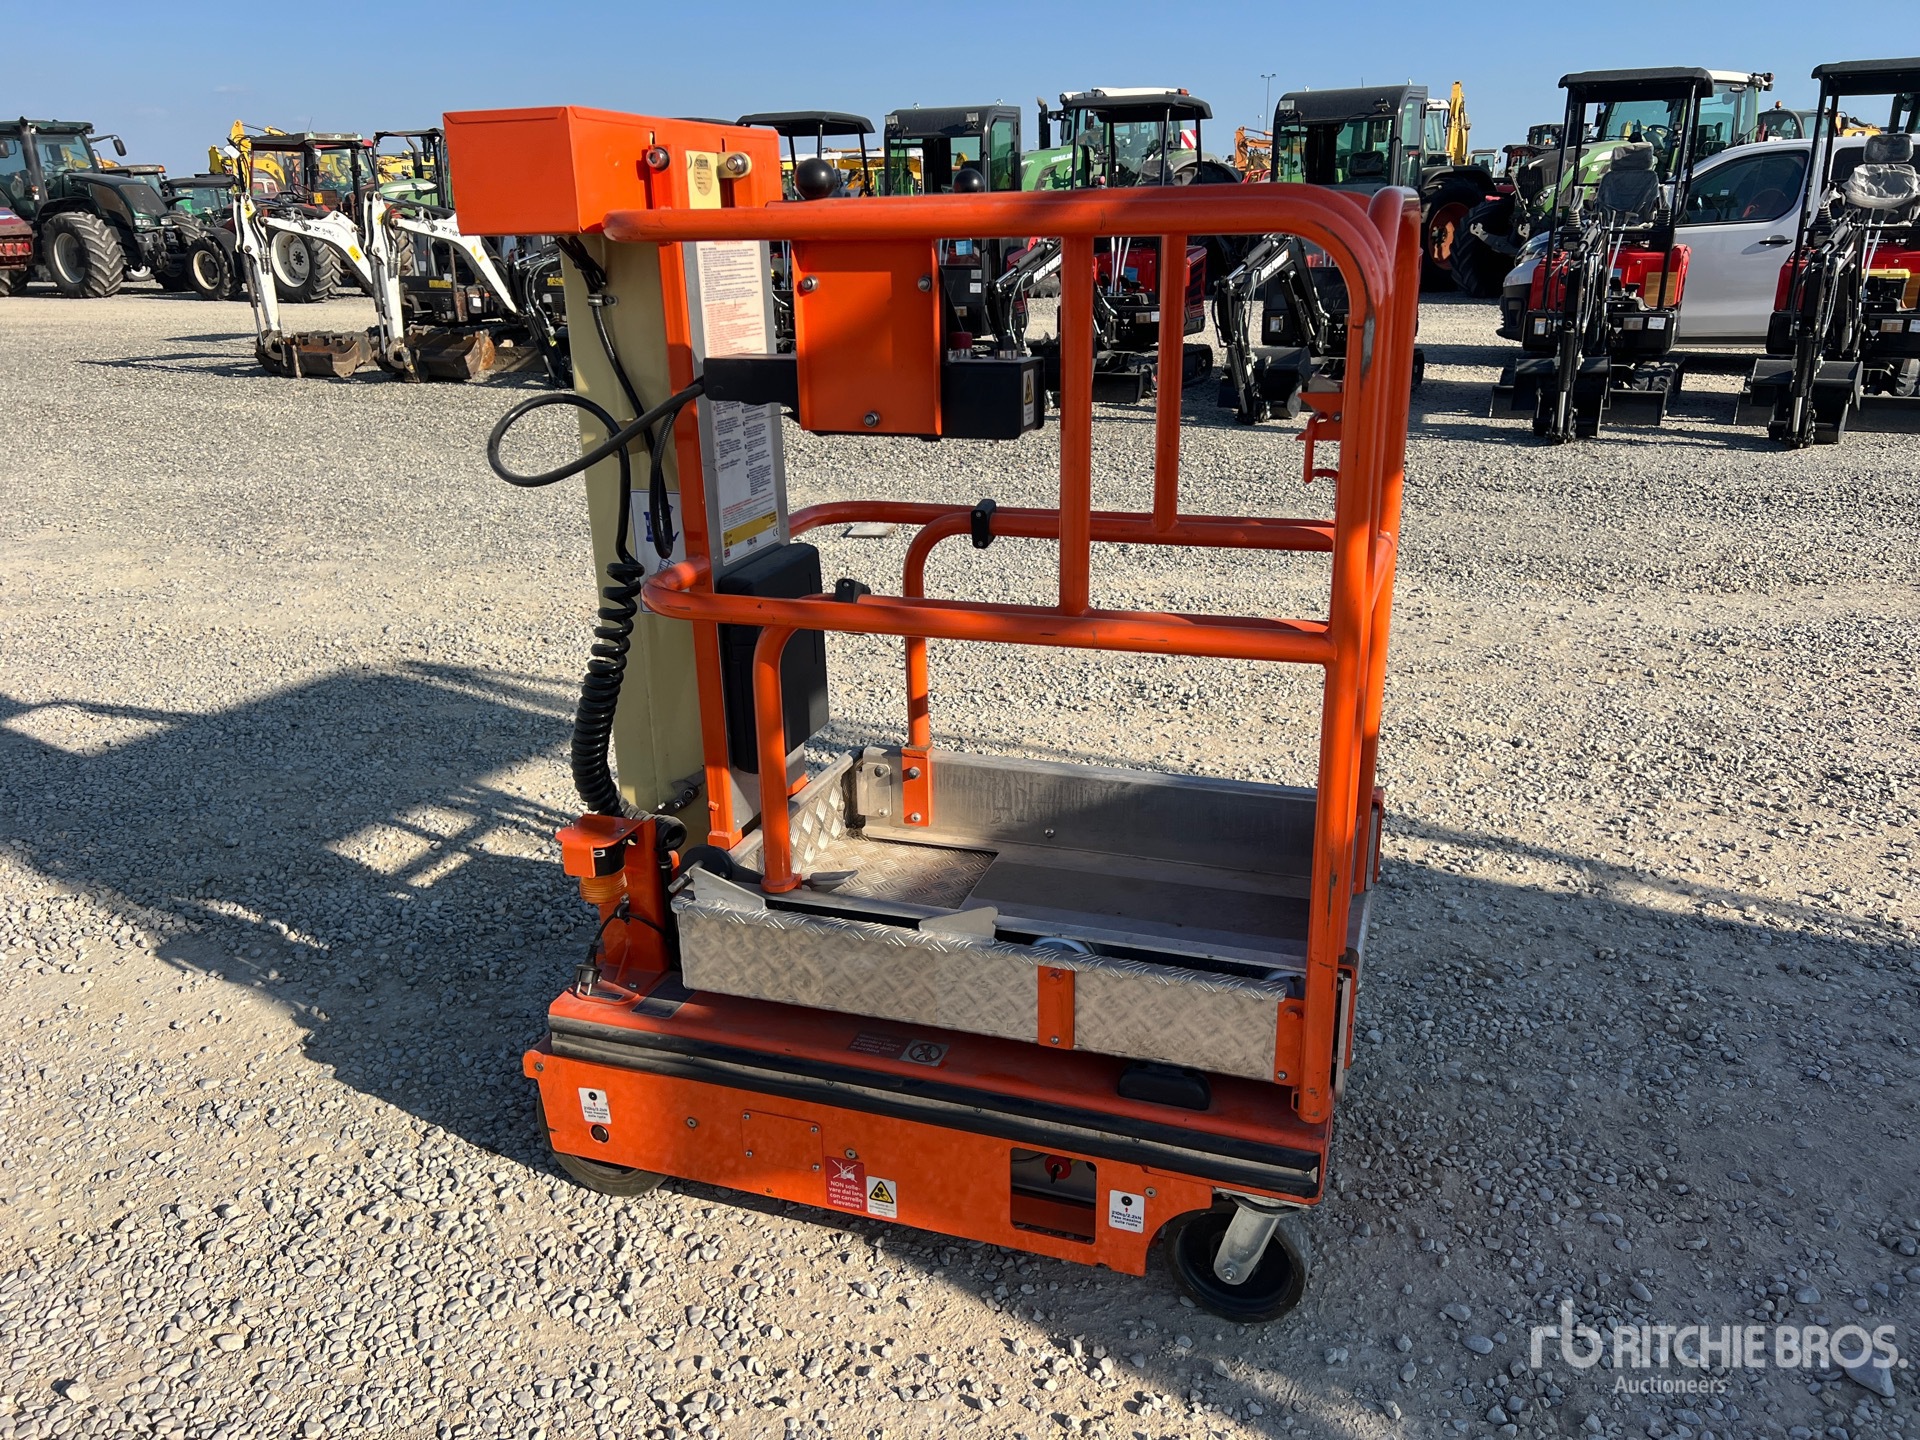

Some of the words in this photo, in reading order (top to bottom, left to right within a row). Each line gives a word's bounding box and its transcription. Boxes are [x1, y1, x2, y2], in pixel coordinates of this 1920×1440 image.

[830, 1180, 844, 1188] NON
[845, 1183, 861, 1191] solle-
[842, 1188, 851, 1196] dal
[852, 1190, 864, 1198] lato
[841, 1195, 863, 1203] carrello
